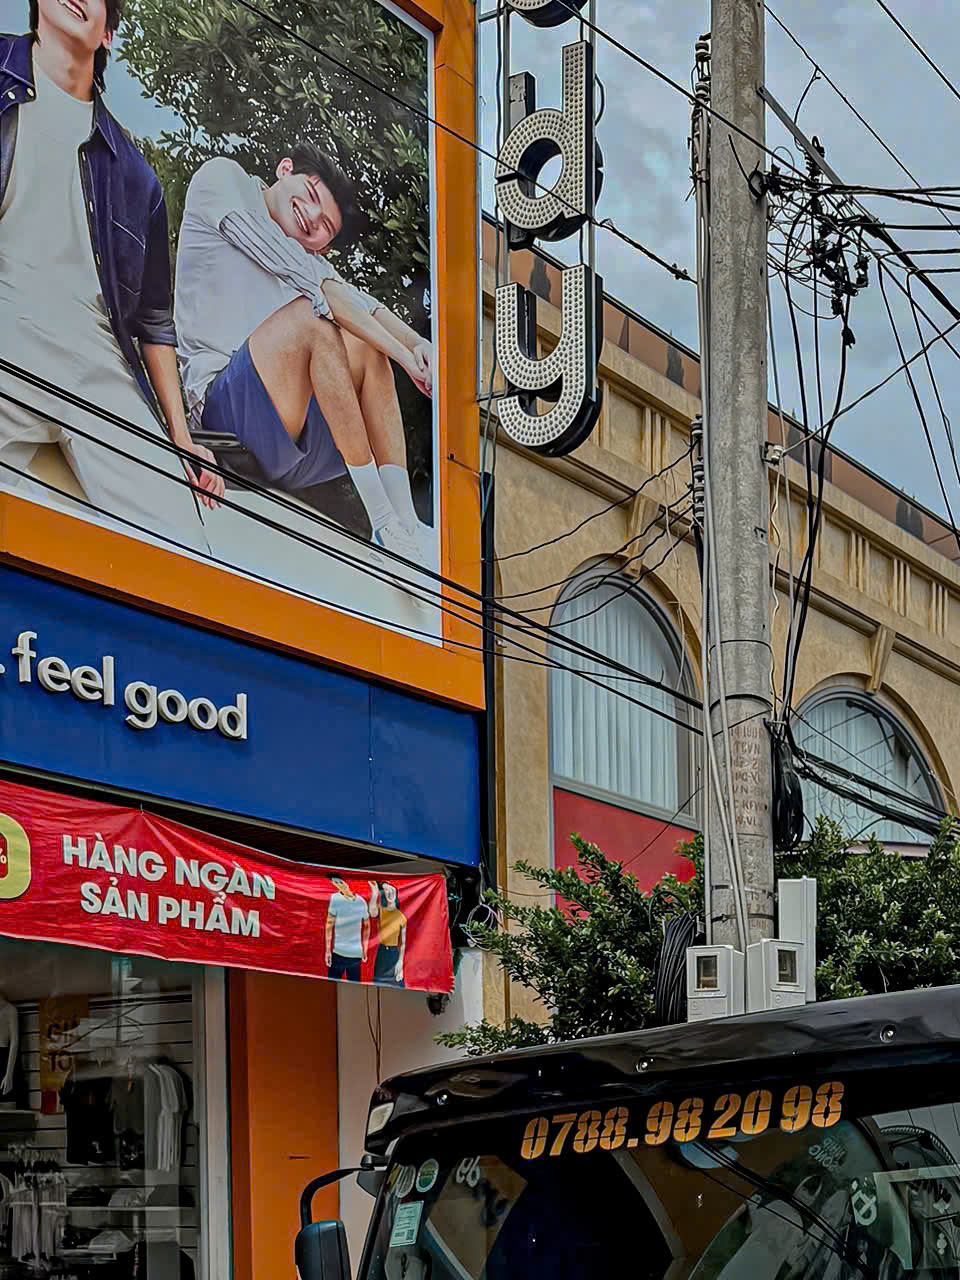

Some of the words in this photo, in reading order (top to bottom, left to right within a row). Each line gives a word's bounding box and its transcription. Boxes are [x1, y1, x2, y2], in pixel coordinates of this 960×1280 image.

[11, 630, 115, 706] feel
[124, 681, 248, 740] good
[62, 832, 168, 882] HÀNG
[174, 860, 276, 900] NGÀN
[80, 876, 150, 923] SẢN
[157, 891, 260, 938] PHẨM
[706, 1088, 773, 1139] 20
[779, 1080, 845, 1135] 98
